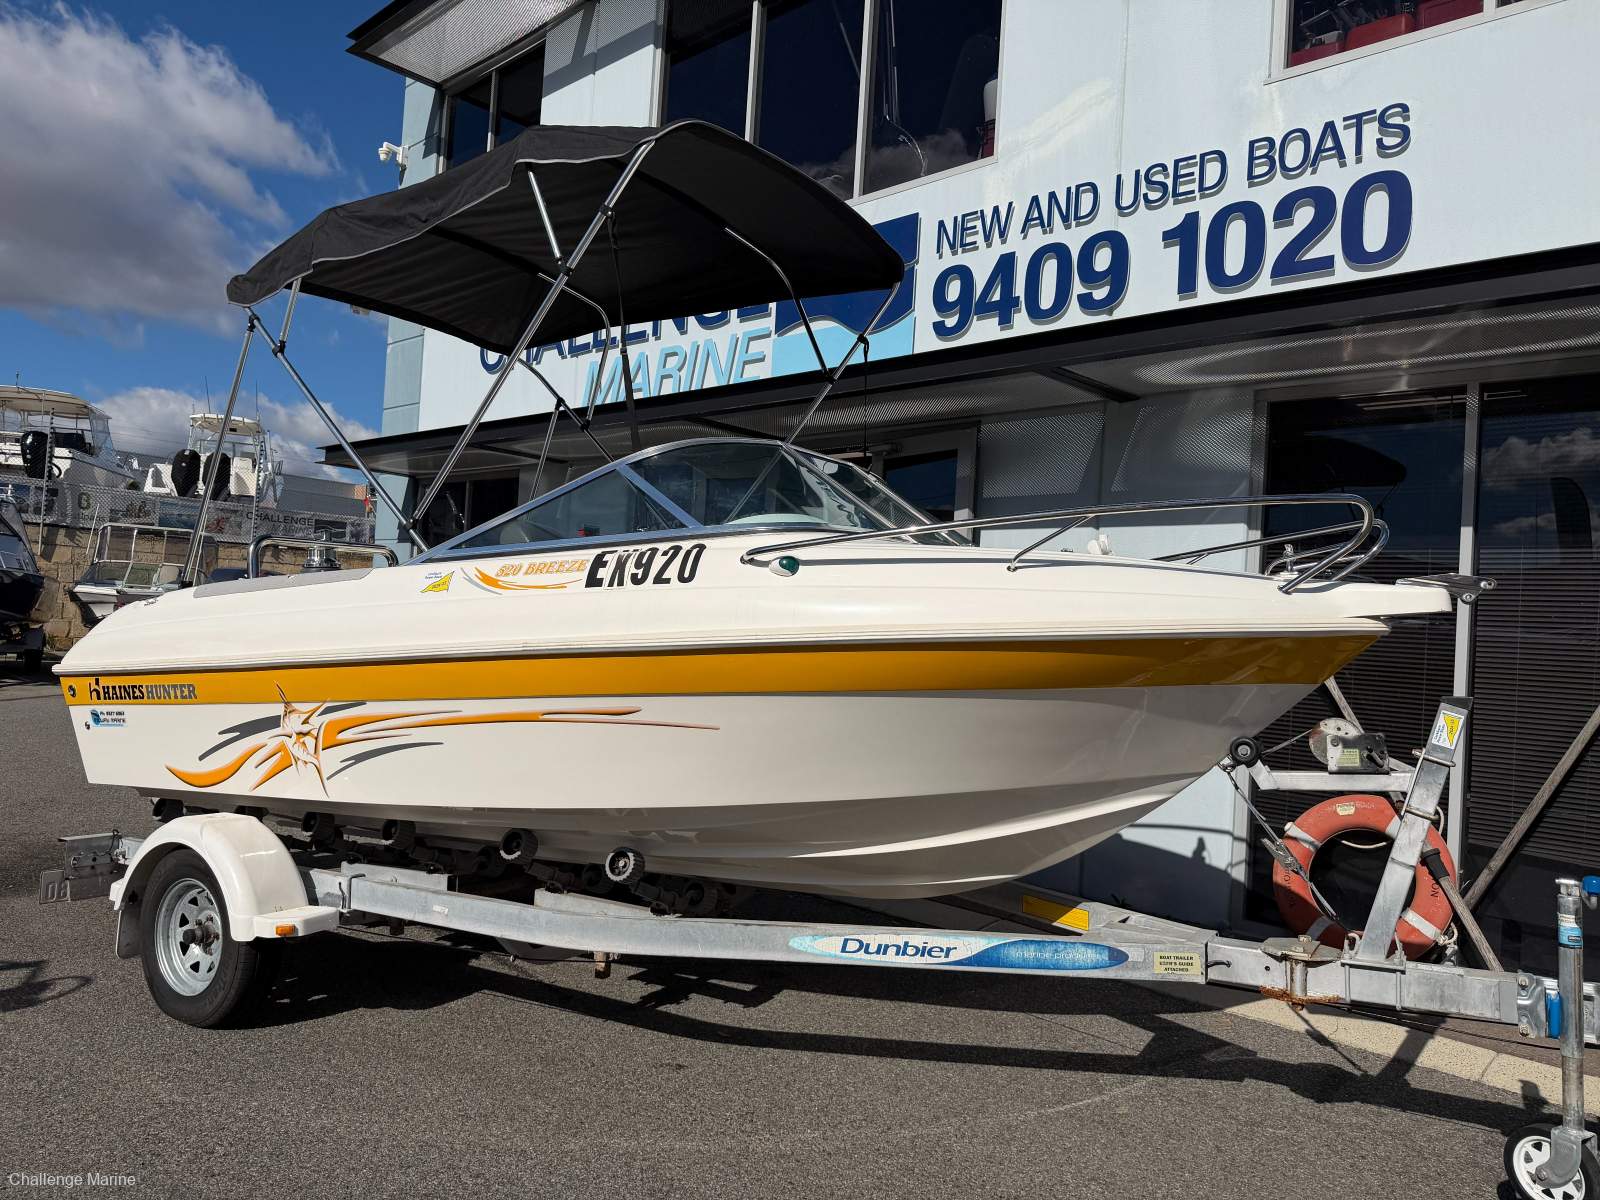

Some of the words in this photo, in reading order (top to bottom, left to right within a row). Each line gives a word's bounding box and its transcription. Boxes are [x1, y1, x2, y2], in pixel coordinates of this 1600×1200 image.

[936, 201, 1015, 259] NEW
[1020, 181, 1100, 240] AND
[1114, 149, 1228, 217] USED
[1247, 102, 1411, 188] BOATS
[932, 229, 1130, 343] 9409
[1161, 169, 1413, 302] 1020
[580, 327, 773, 408] MARINE
[246, 511, 314, 527] CHALLENGE
[524, 558, 589, 576] BREEZE
[585, 543, 707, 589] EX920
[102, 684, 145, 701] HAINES
[145, 683, 198, 700] HUNTER
[840, 937, 957, 959] Dunbier
